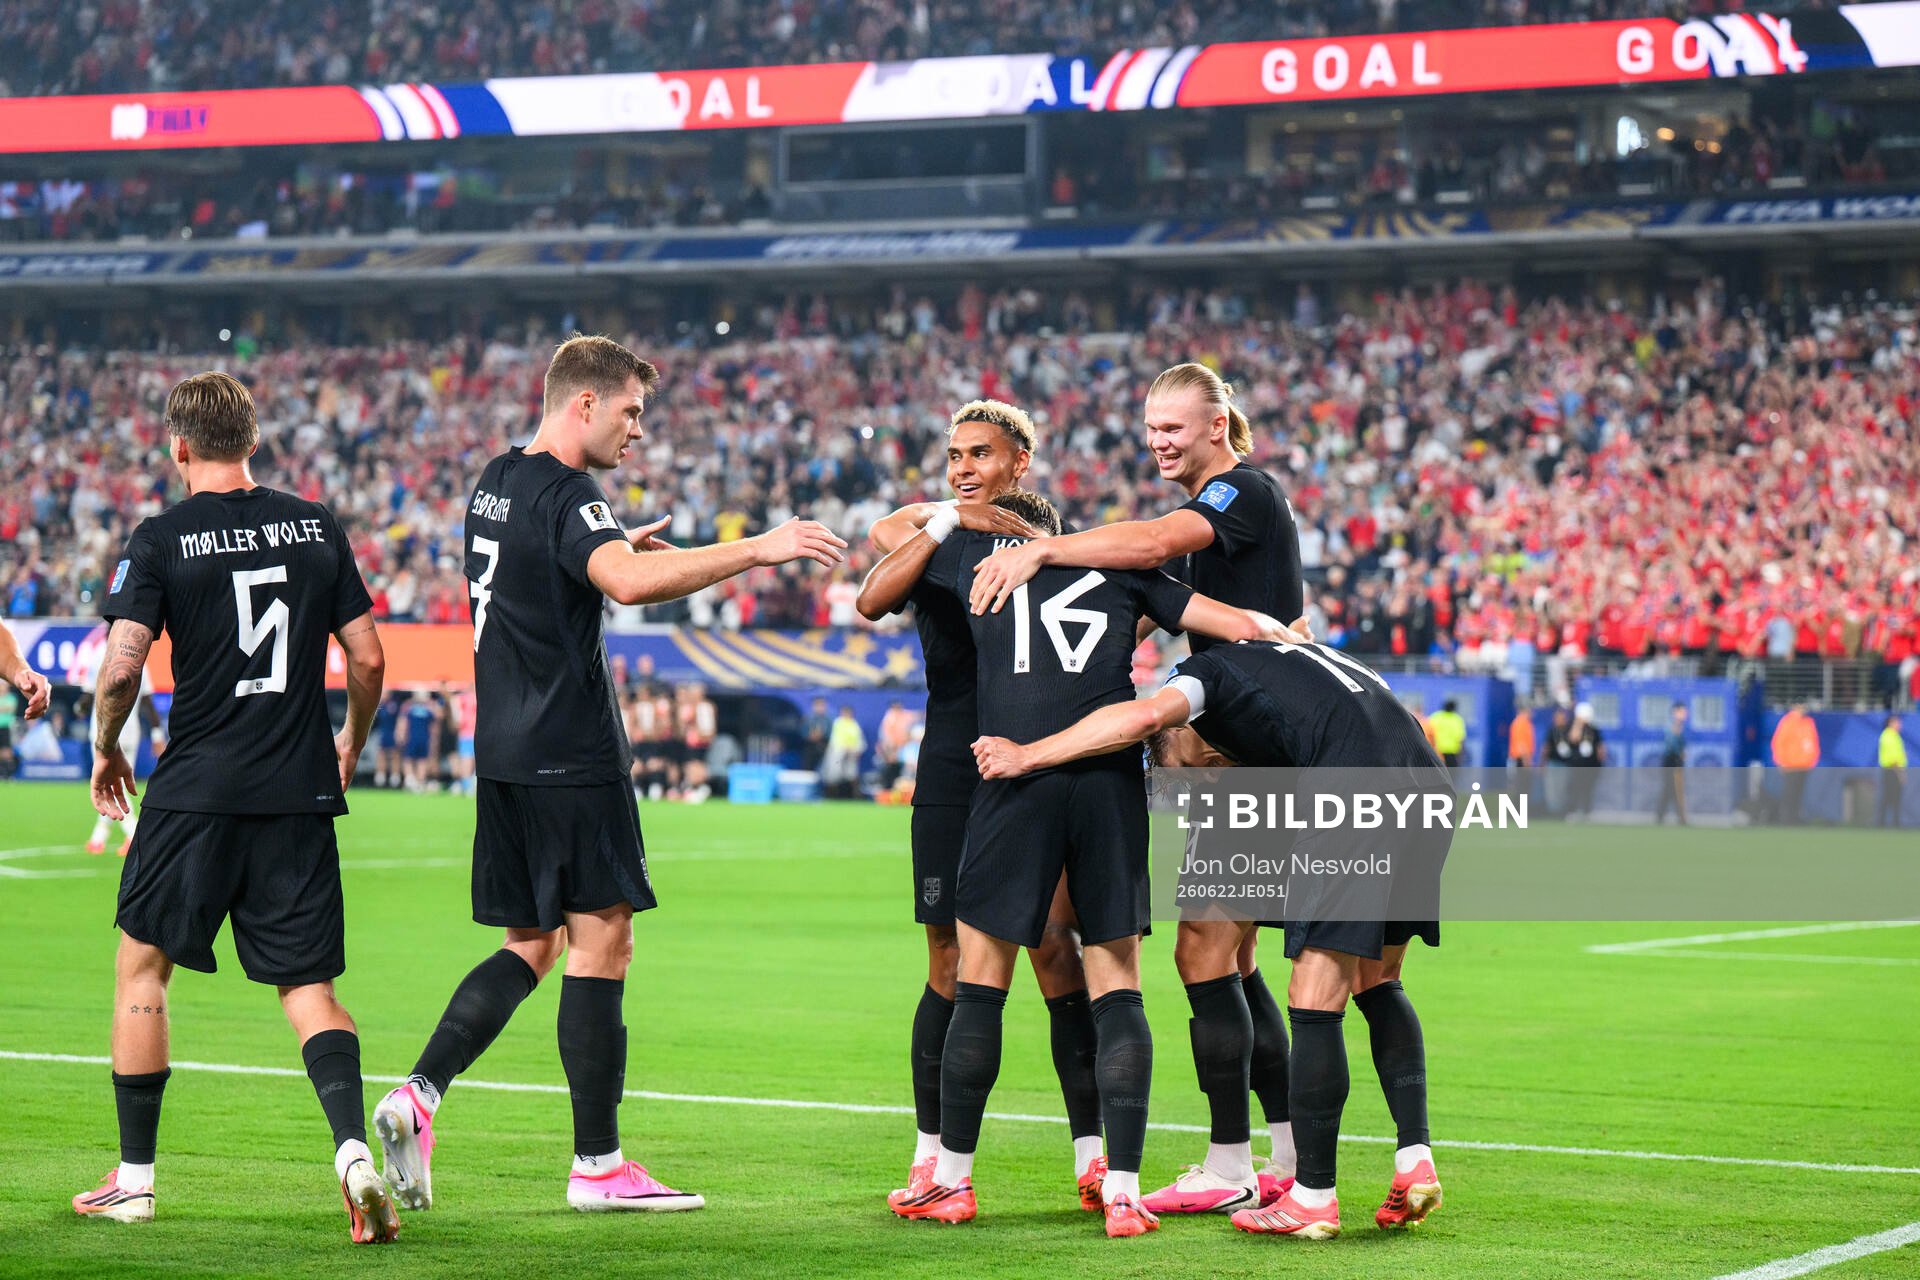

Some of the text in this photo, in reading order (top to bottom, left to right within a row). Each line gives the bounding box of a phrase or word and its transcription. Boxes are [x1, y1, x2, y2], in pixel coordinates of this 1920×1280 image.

[1261, 40, 1442, 94] GOAL
[180, 519, 325, 559] MØLLER WOLFE
[232, 565, 289, 697] 5
[471, 535, 499, 653] 7
[1013, 570, 1107, 673] 16
